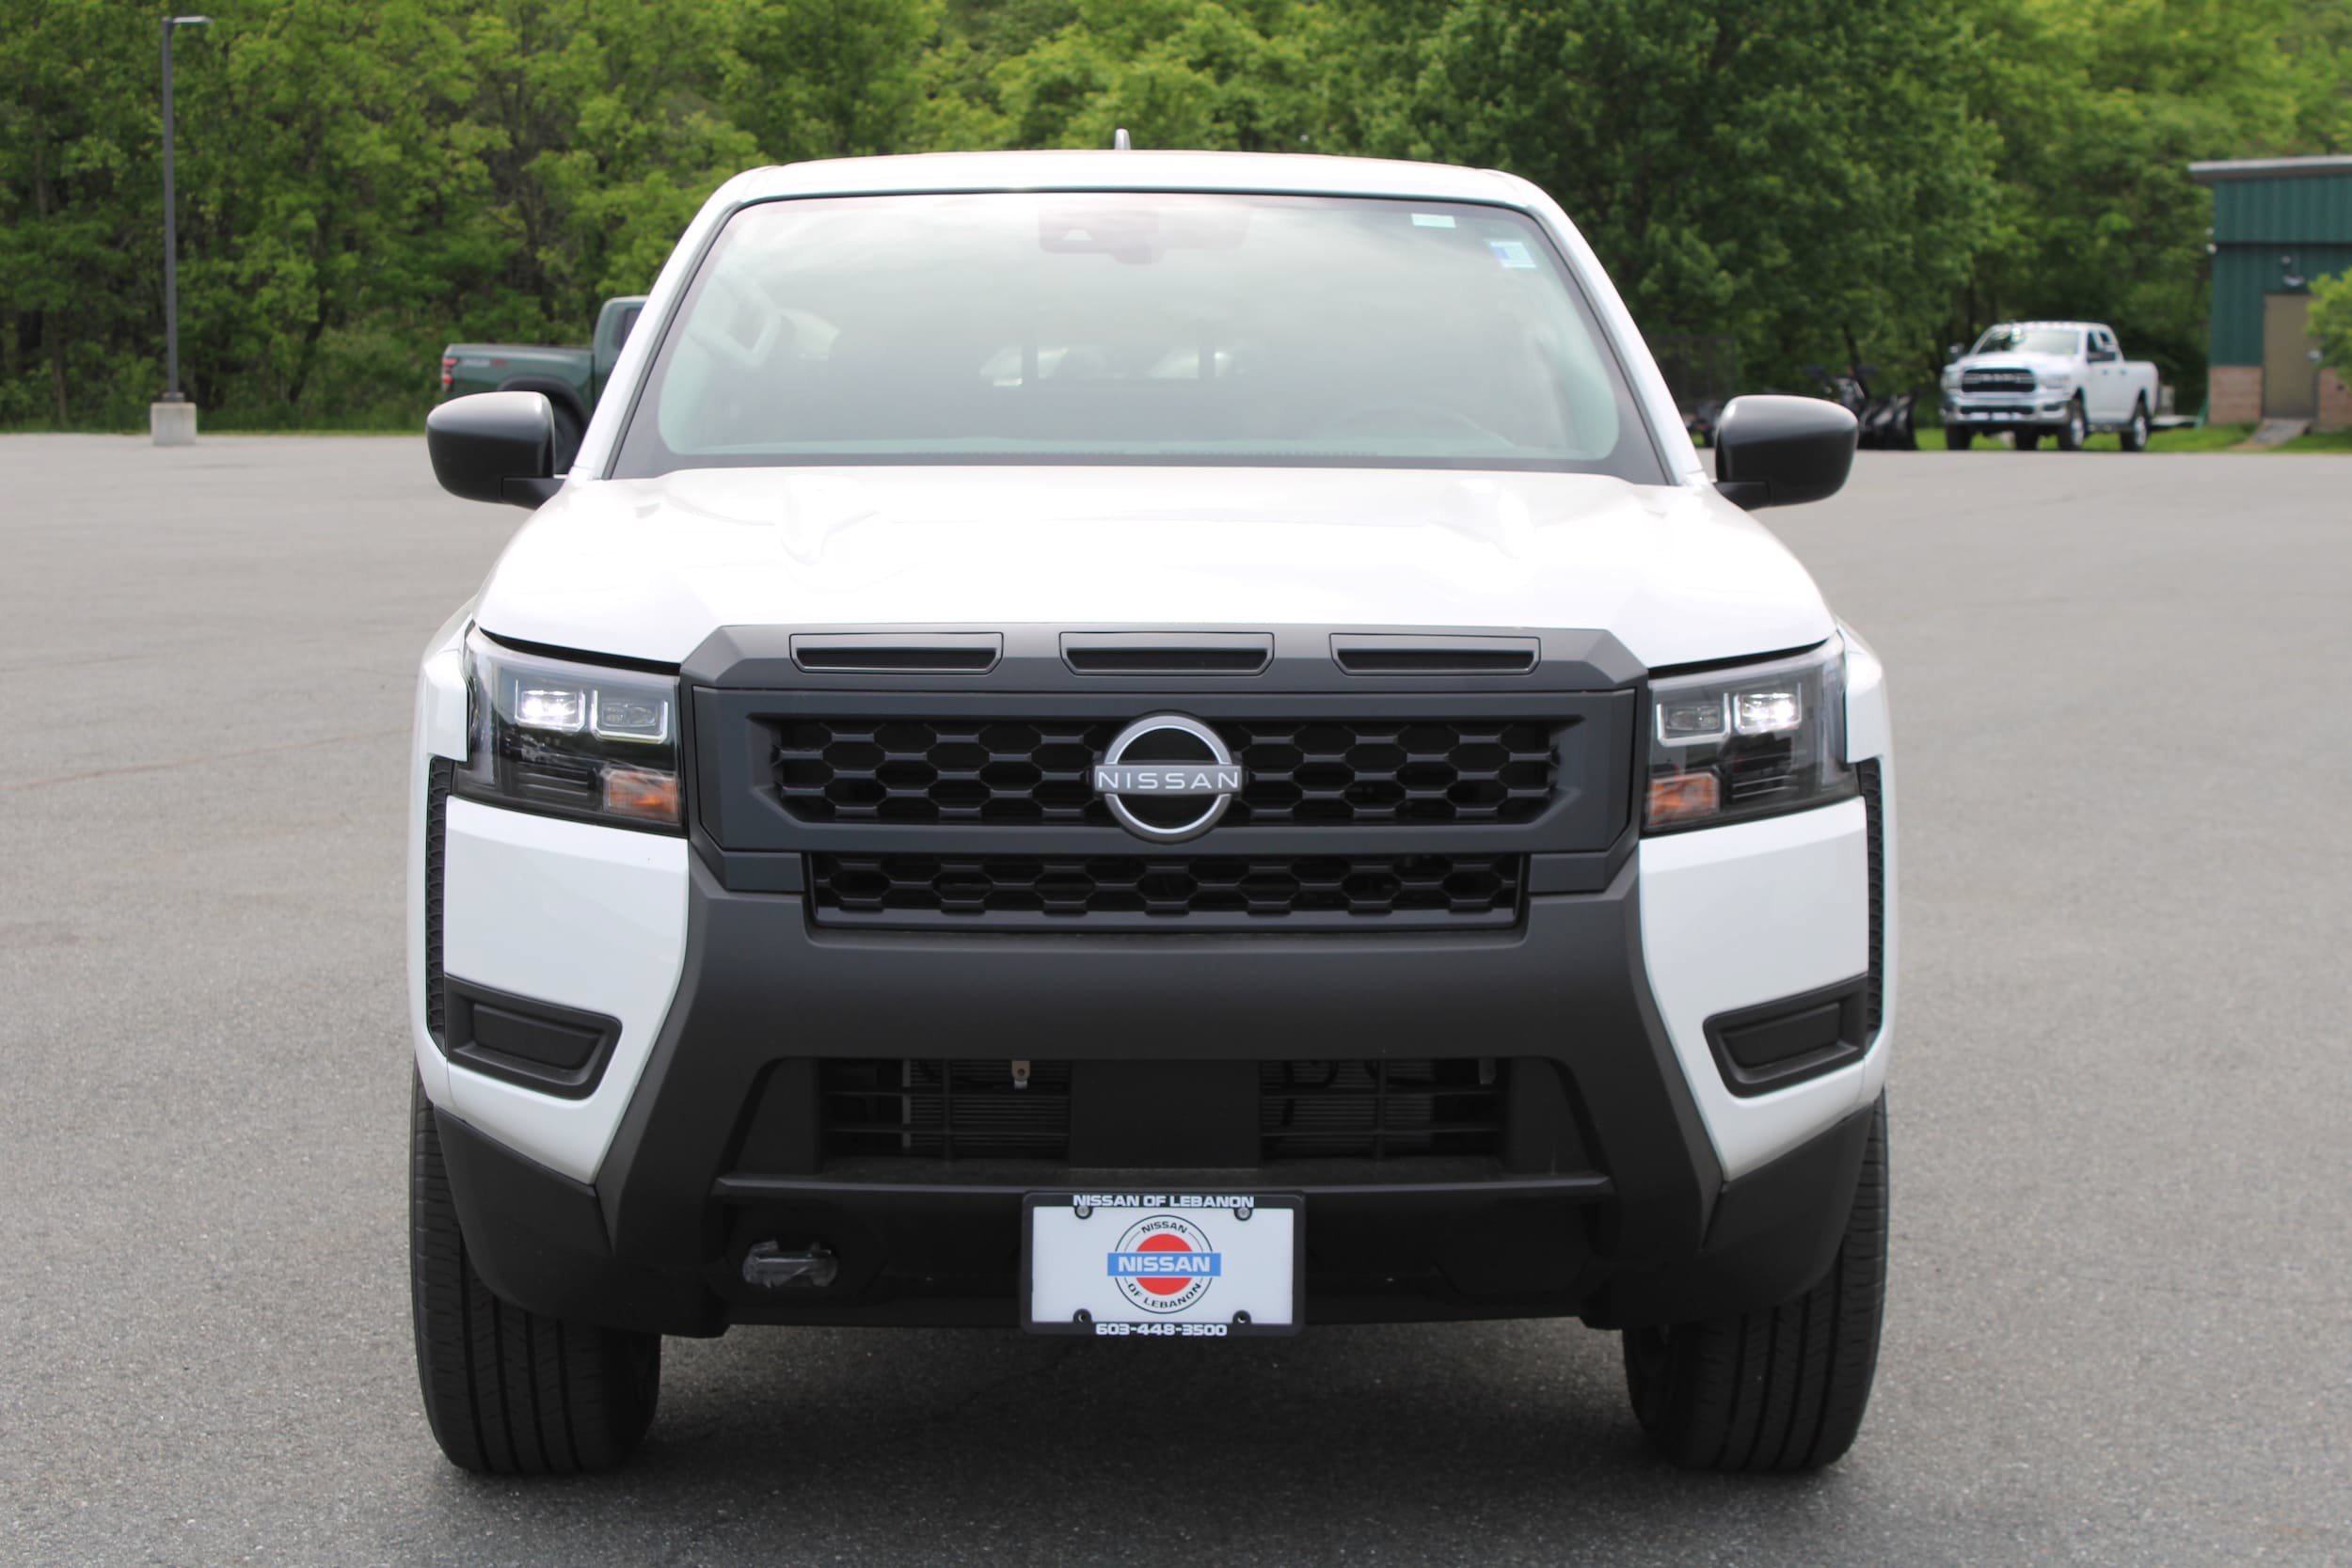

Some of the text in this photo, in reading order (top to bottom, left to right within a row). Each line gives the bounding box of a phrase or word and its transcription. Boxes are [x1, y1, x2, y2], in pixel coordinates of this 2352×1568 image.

[1098, 771, 1238, 789] NISSAN
[1073, 1195, 1255, 1208] NISSAN OF LEBANON
[1140, 1221, 1187, 1234] NISSAN
[1118, 1256, 1211, 1272] NISSAN
[1128, 1282, 1201, 1308] OF LEBANON
[1095, 1323, 1228, 1337] 603-448-3500
